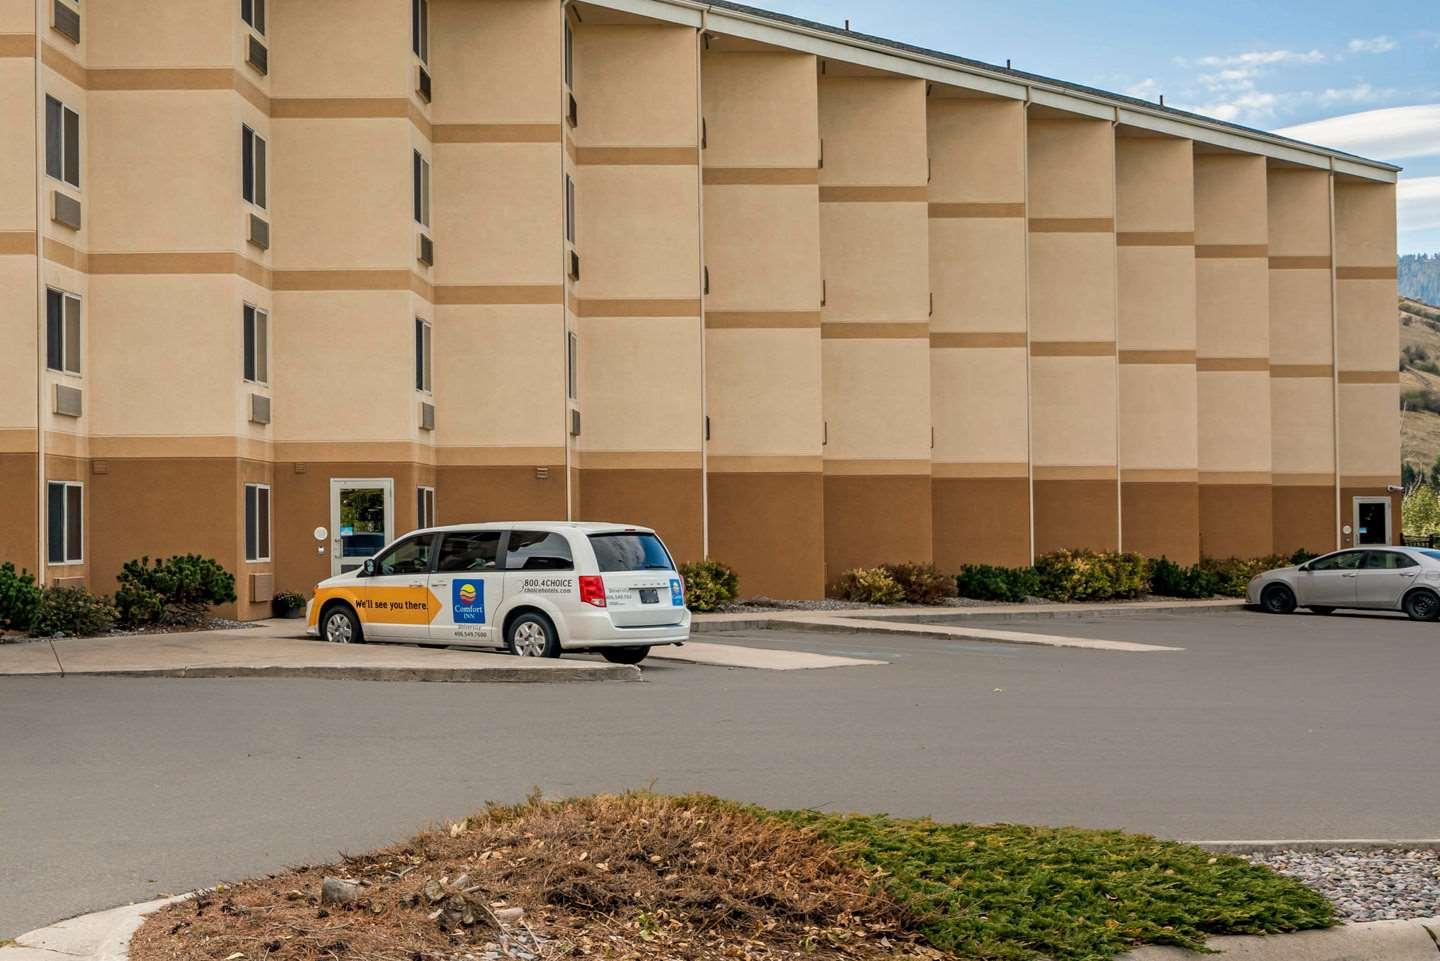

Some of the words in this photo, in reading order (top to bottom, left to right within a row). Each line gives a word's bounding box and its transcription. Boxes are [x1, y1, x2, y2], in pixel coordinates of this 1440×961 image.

[355, 599, 372, 609] We'll
[375, 601, 388, 609] see
[389, 601, 403, 611] you
